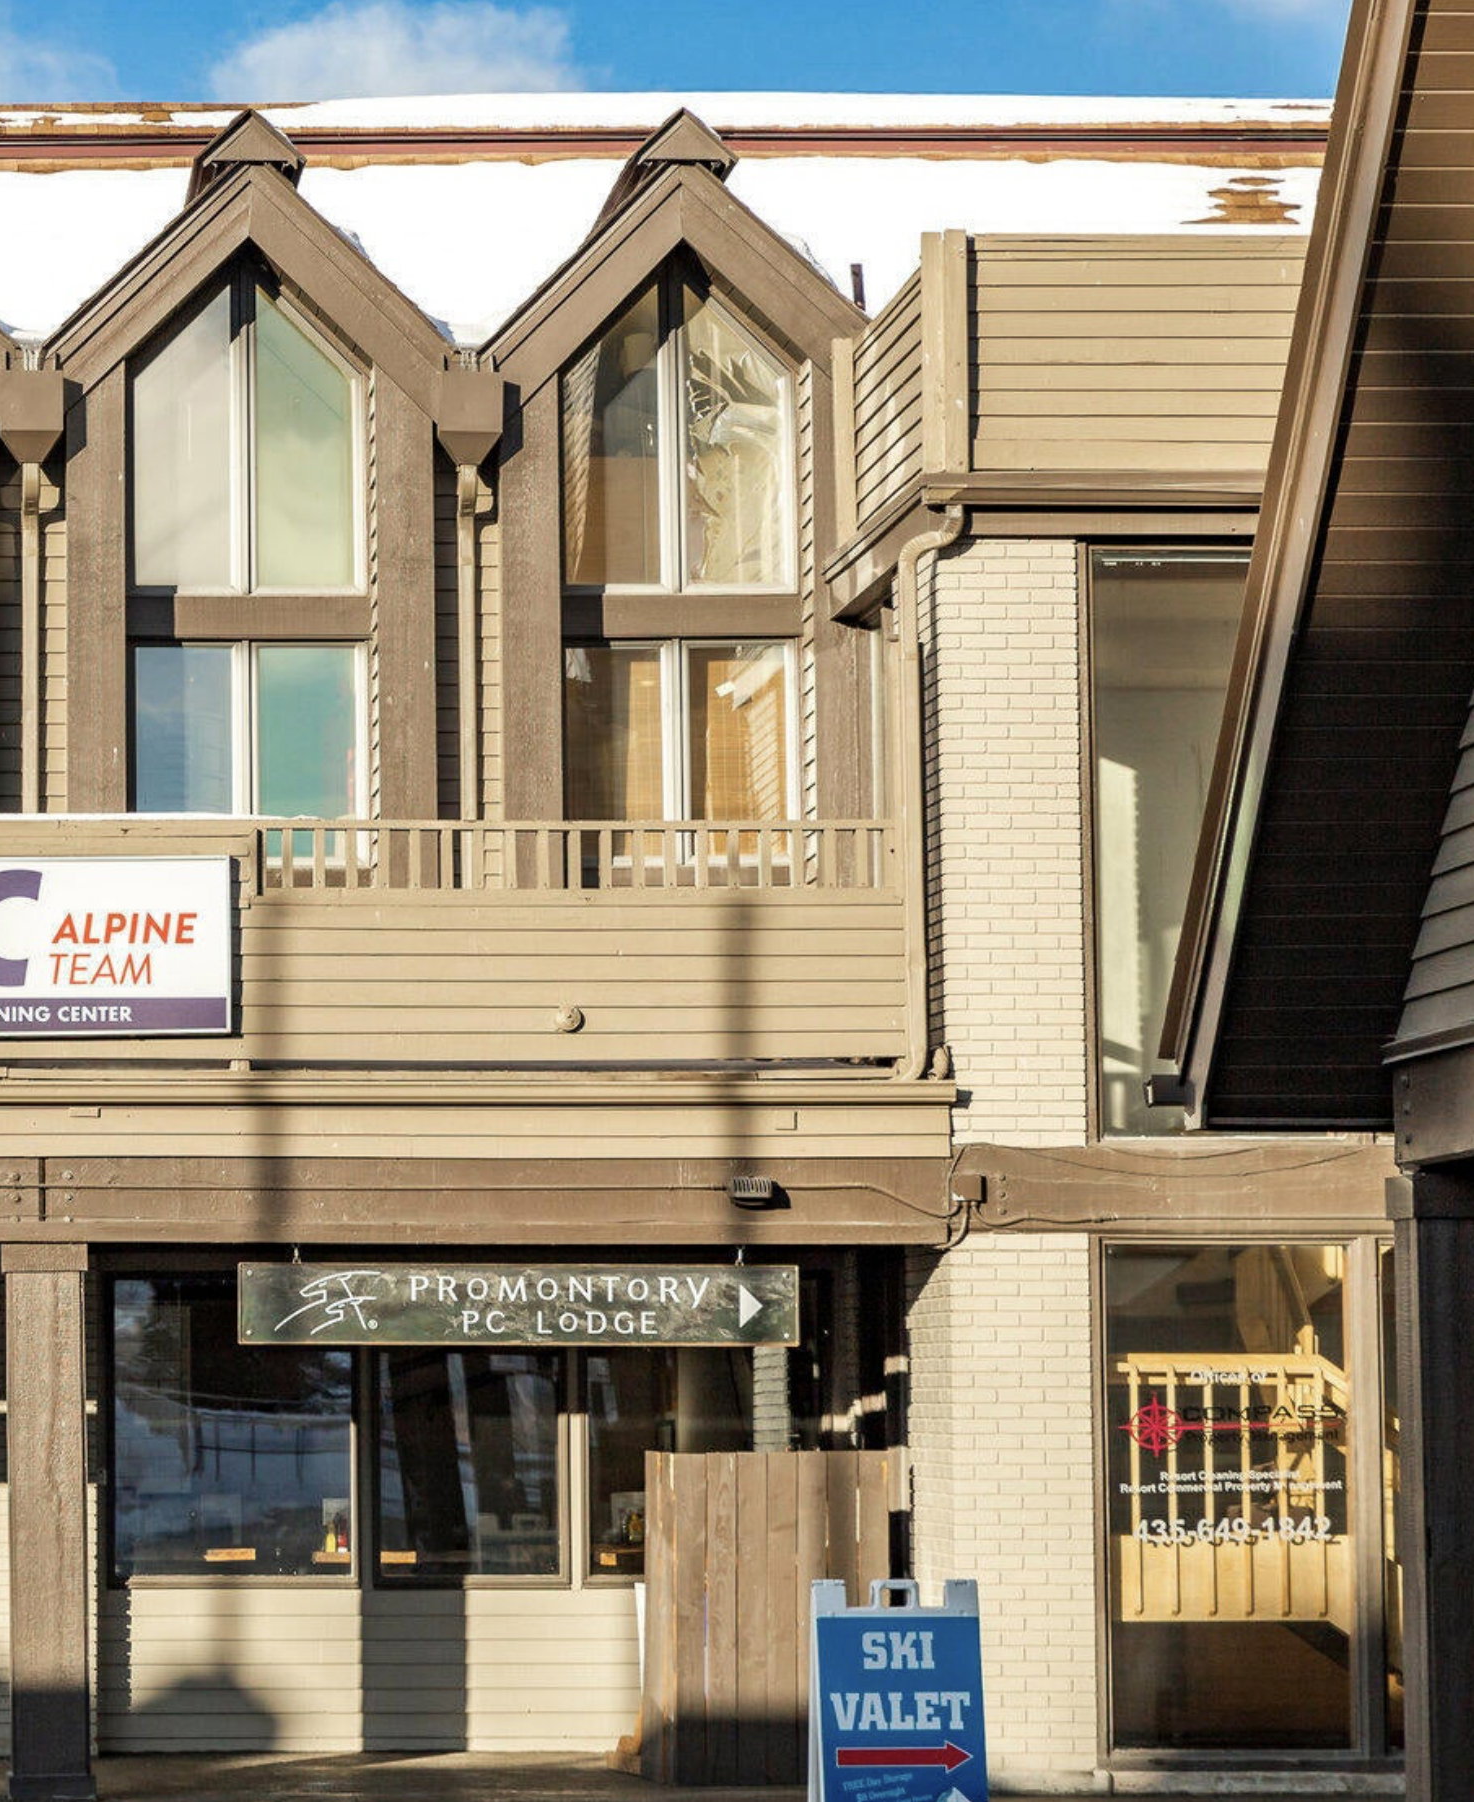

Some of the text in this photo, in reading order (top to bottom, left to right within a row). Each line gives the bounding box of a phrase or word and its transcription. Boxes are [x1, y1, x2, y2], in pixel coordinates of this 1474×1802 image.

[51, 912, 199, 945] ALPINE
[49, 953, 153, 985] TEAM
[57, 1006, 133, 1023] CENTER
[409, 1276, 711, 1309] PROMONTORY
[462, 1310, 659, 1334] PC LODGE
[1131, 1515, 1333, 1544] 435-649-1842
[861, 1631, 937, 1670] SKI
[829, 1691, 971, 1731] VALET
